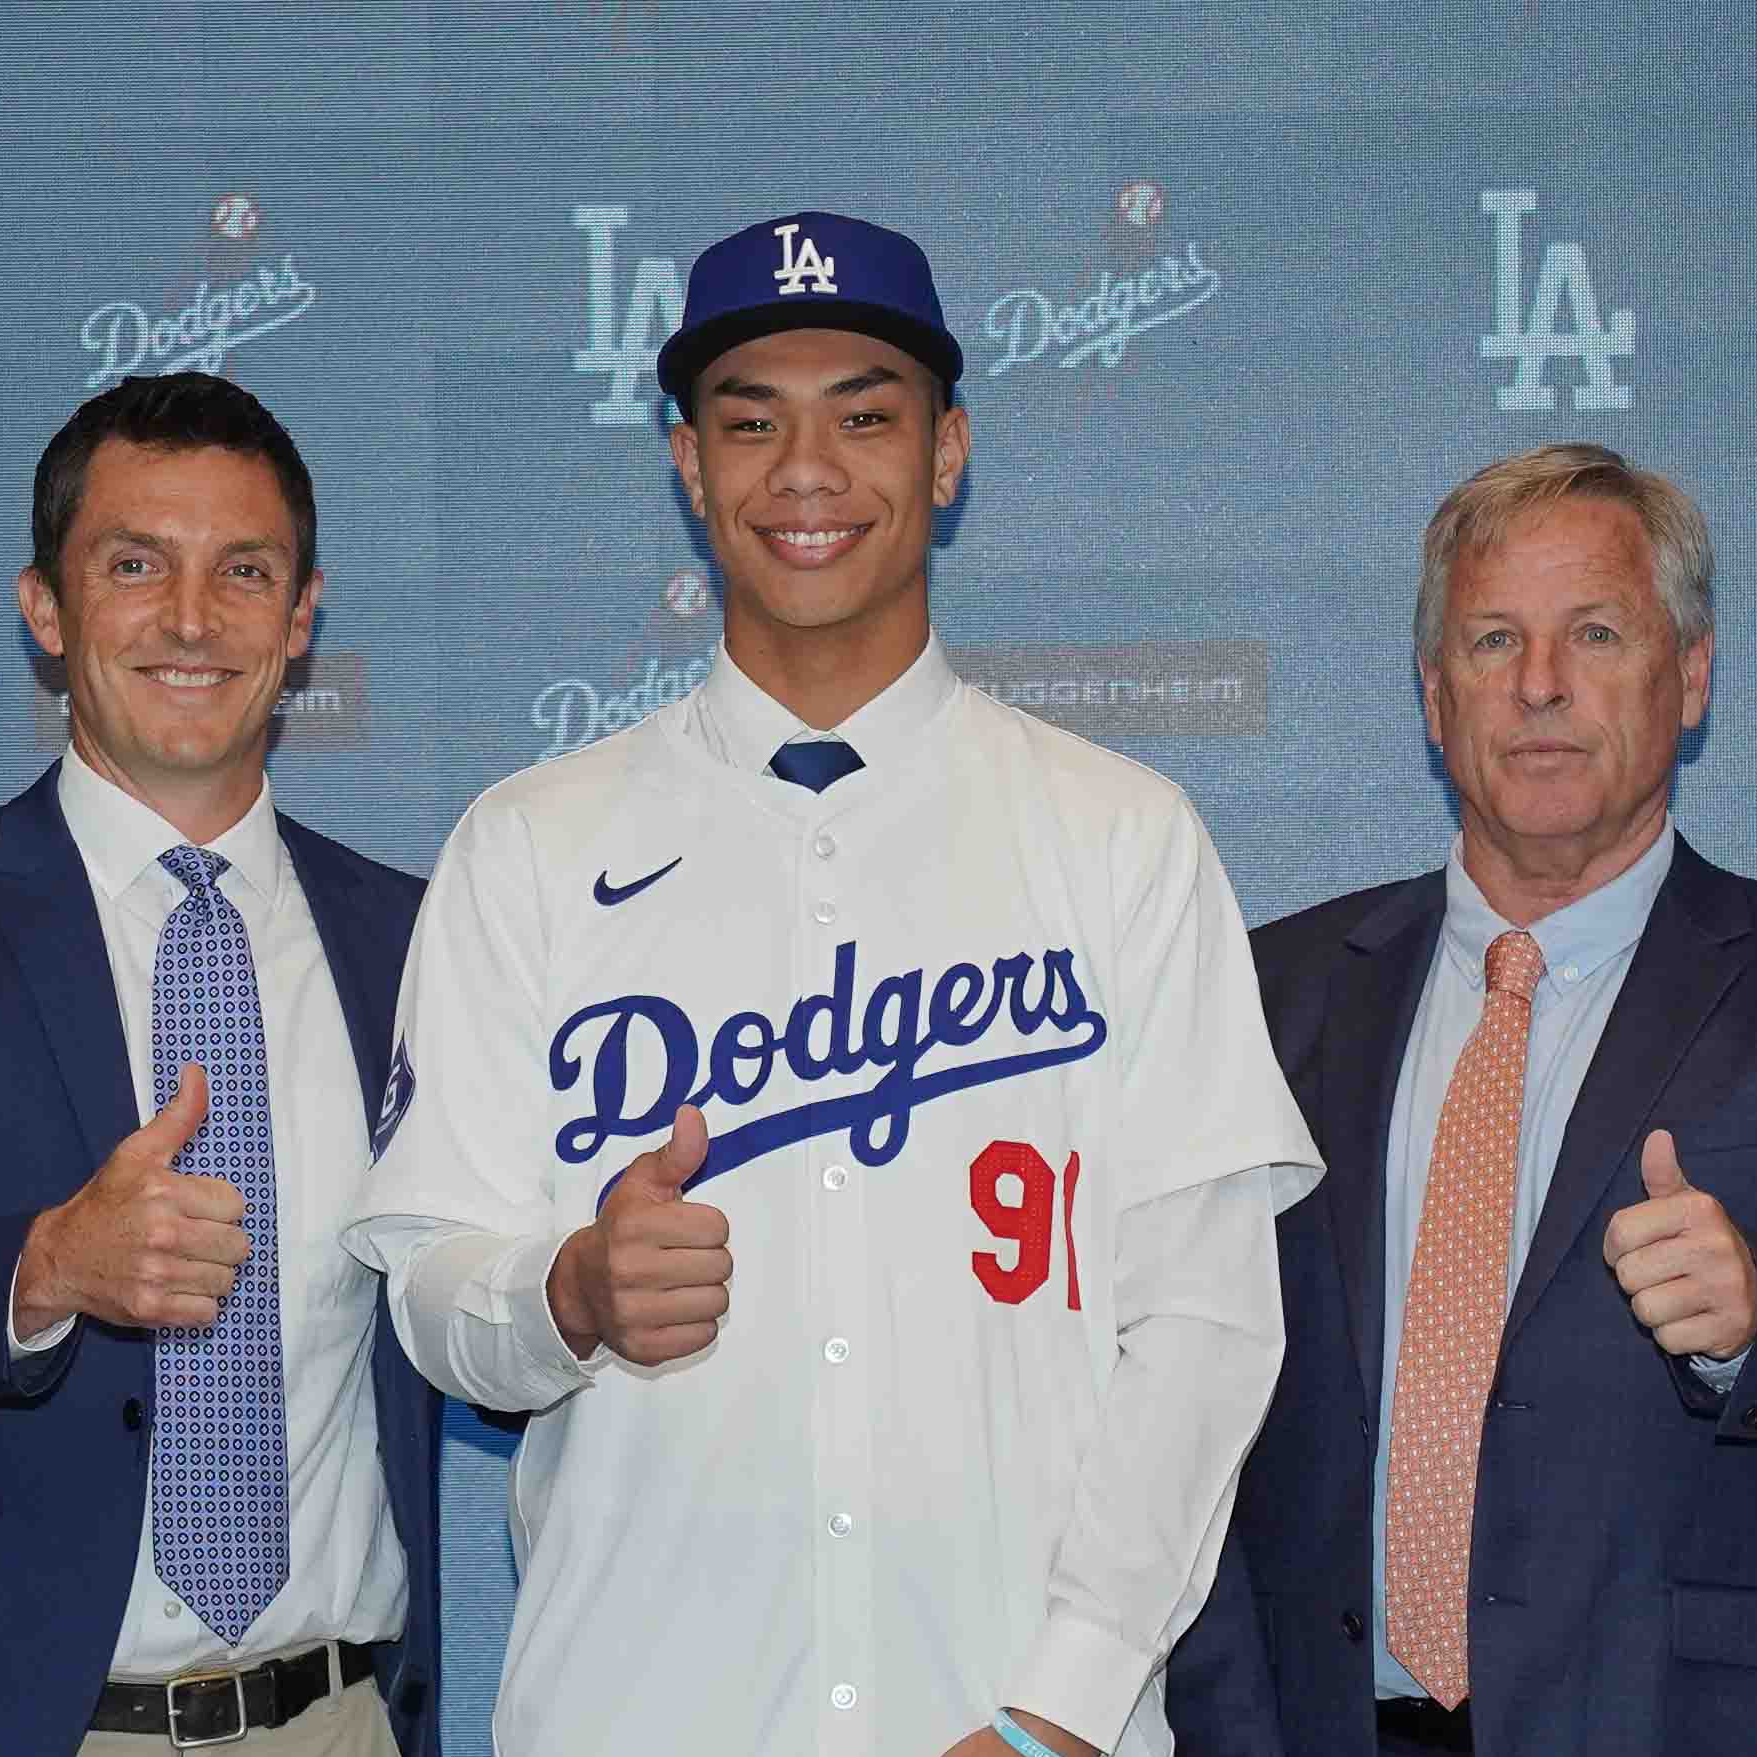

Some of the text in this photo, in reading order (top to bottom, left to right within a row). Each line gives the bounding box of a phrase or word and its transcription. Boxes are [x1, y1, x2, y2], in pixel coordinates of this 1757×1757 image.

[82, 257, 316, 380] Dodgers
[774, 223, 838, 295] LA
[986, 246, 1219, 375] Dodgers
[1482, 191, 1635, 411] LA
[549, 940, 1108, 1195] Dodgers
